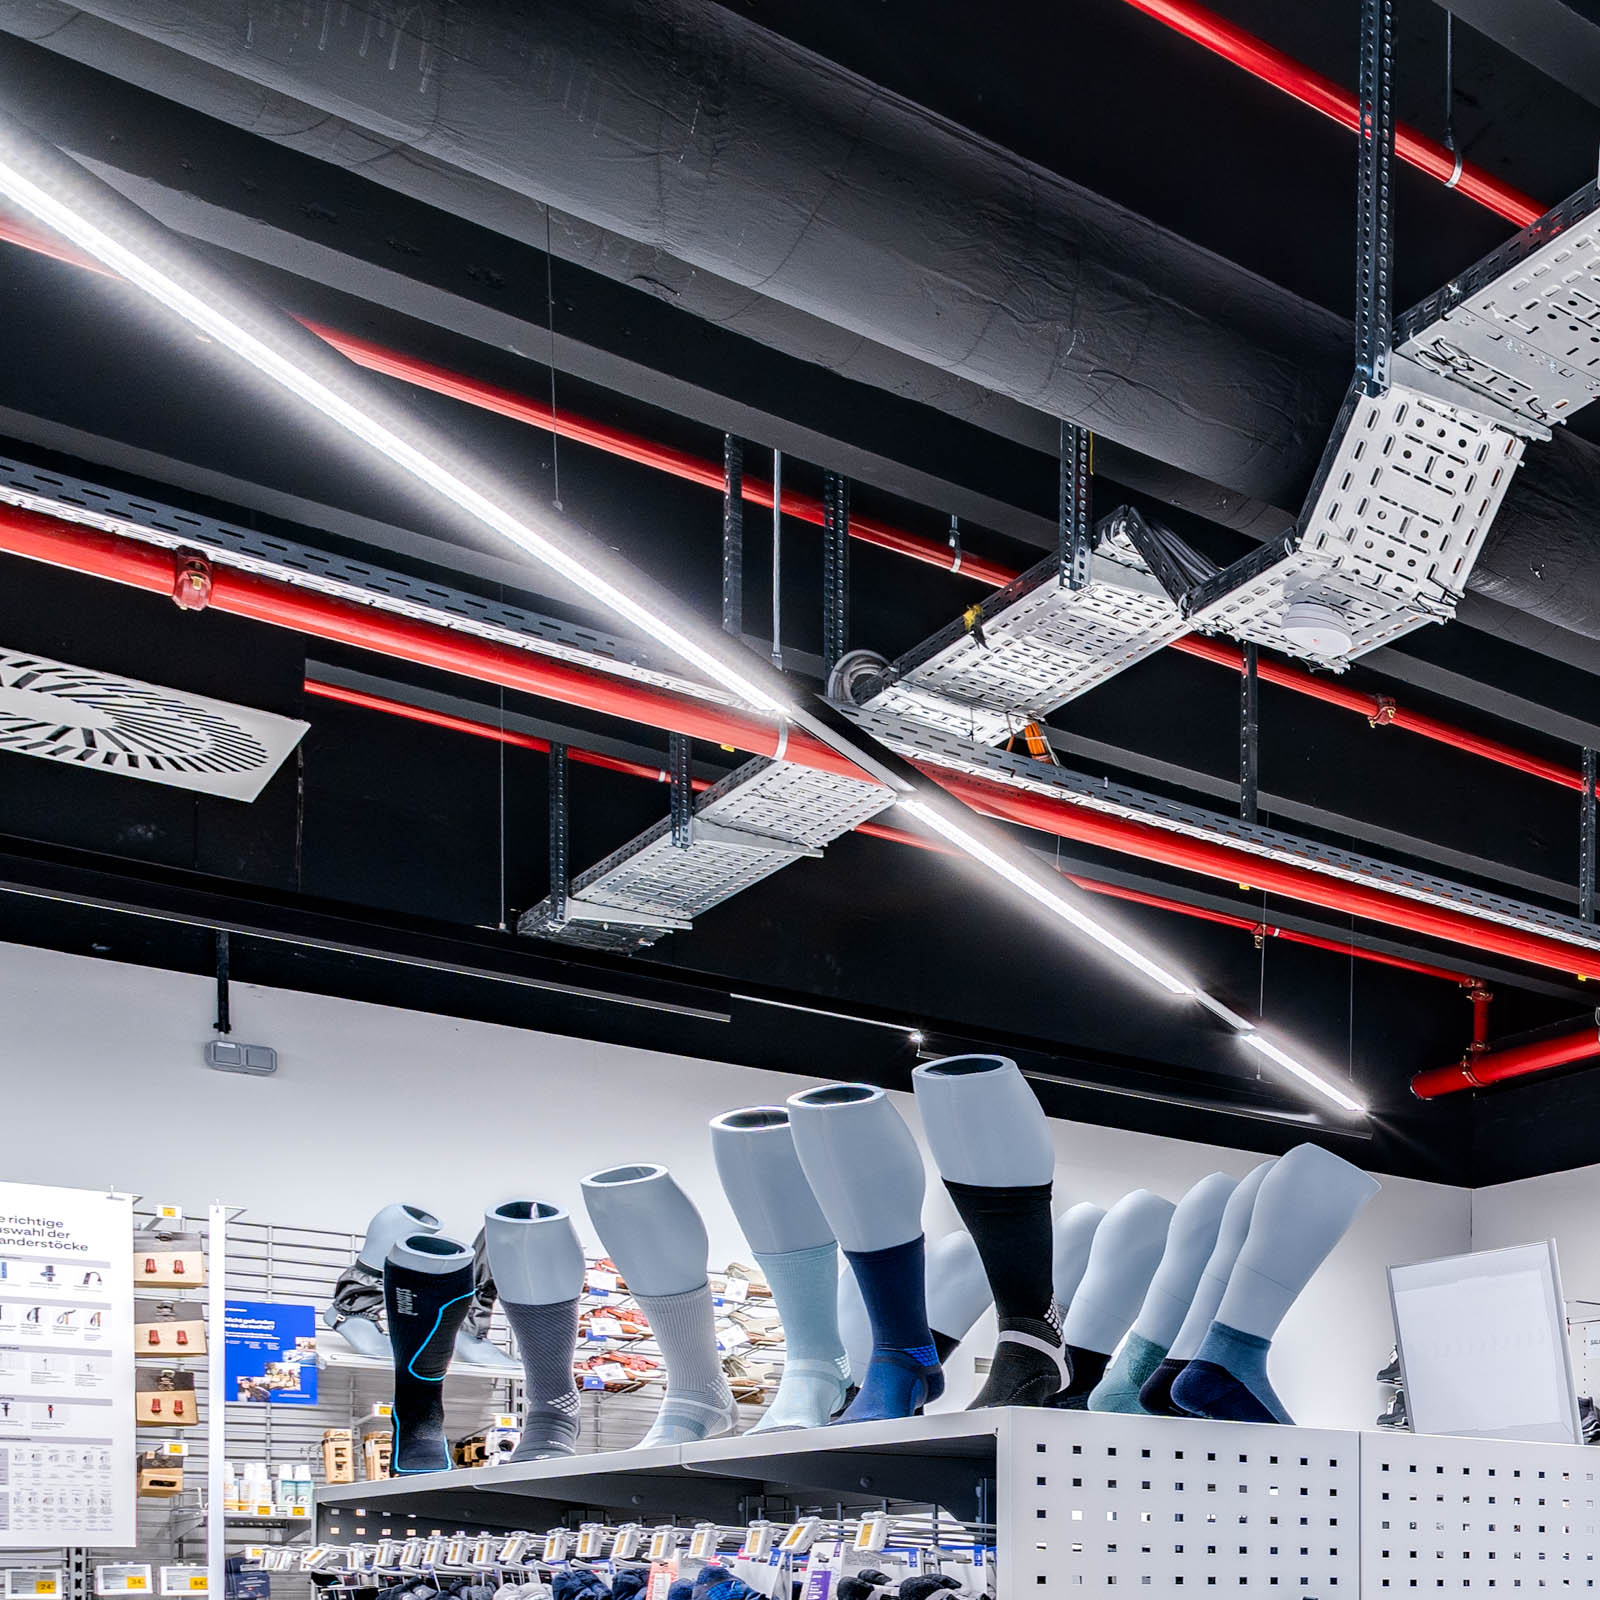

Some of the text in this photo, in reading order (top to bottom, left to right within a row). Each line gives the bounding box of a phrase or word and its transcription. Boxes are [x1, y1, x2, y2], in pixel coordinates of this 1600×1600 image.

[9, 1216, 64, 1229] richtige
[47, 1229, 71, 1239] der
[0, 1237, 89, 1251] anderstöcke
